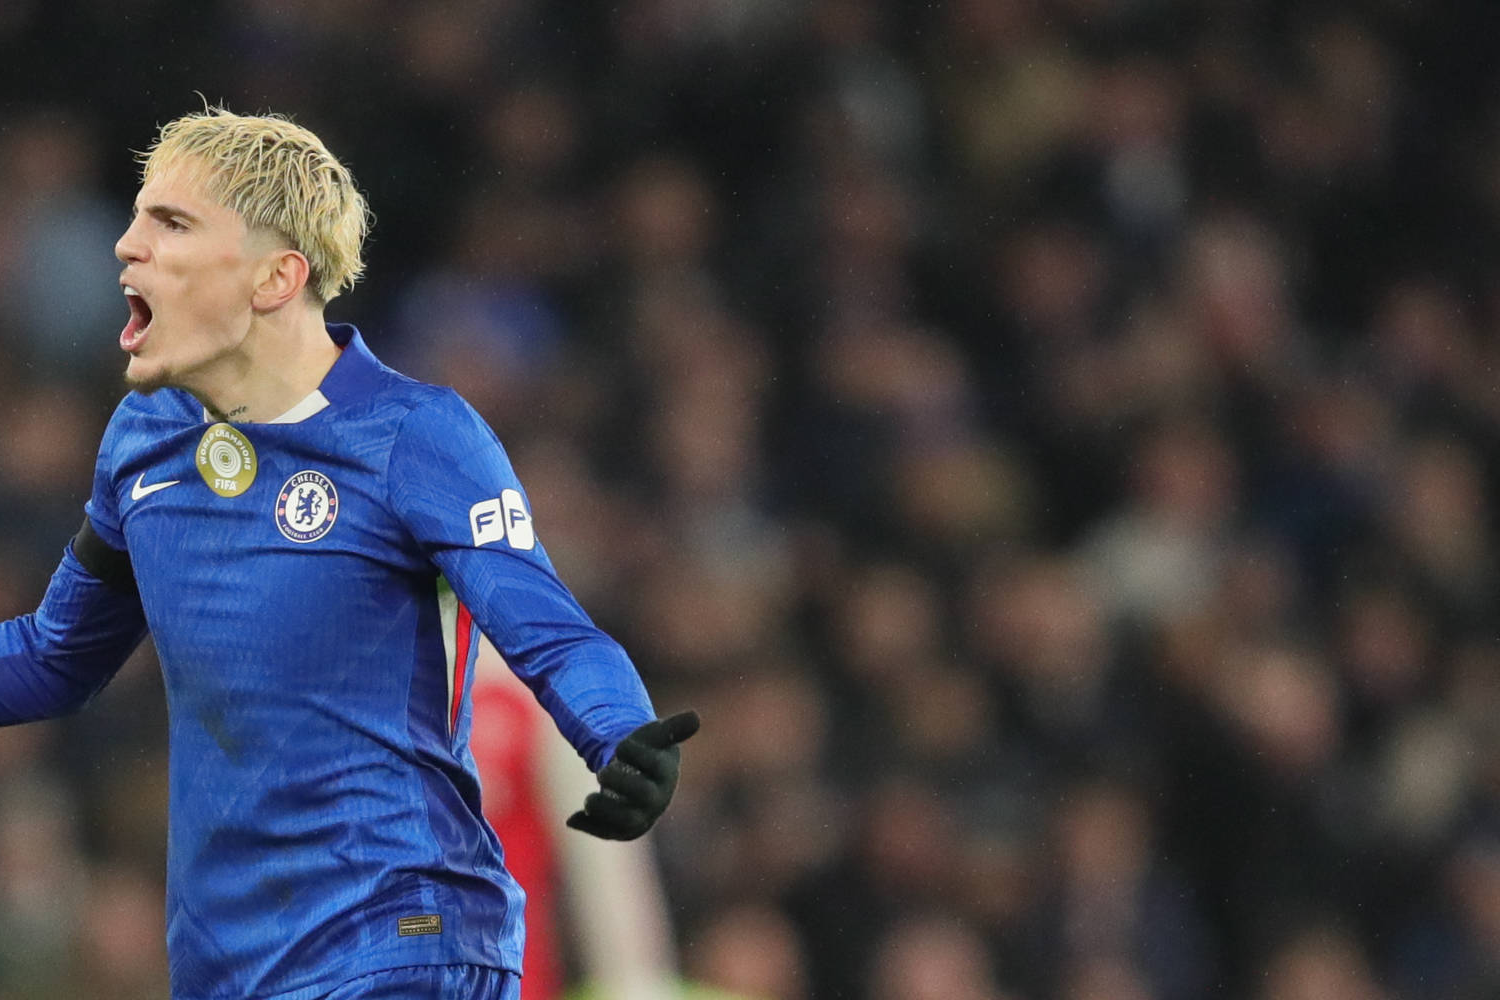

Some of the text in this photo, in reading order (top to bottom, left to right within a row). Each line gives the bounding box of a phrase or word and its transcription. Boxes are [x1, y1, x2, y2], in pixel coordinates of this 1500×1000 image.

[200, 429, 252, 471] WORLD CHAMPIONS
[214, 478, 237, 491] FIFA
[291, 473, 330, 491] CHELSEA
[308, 527, 324, 538] CLUB
